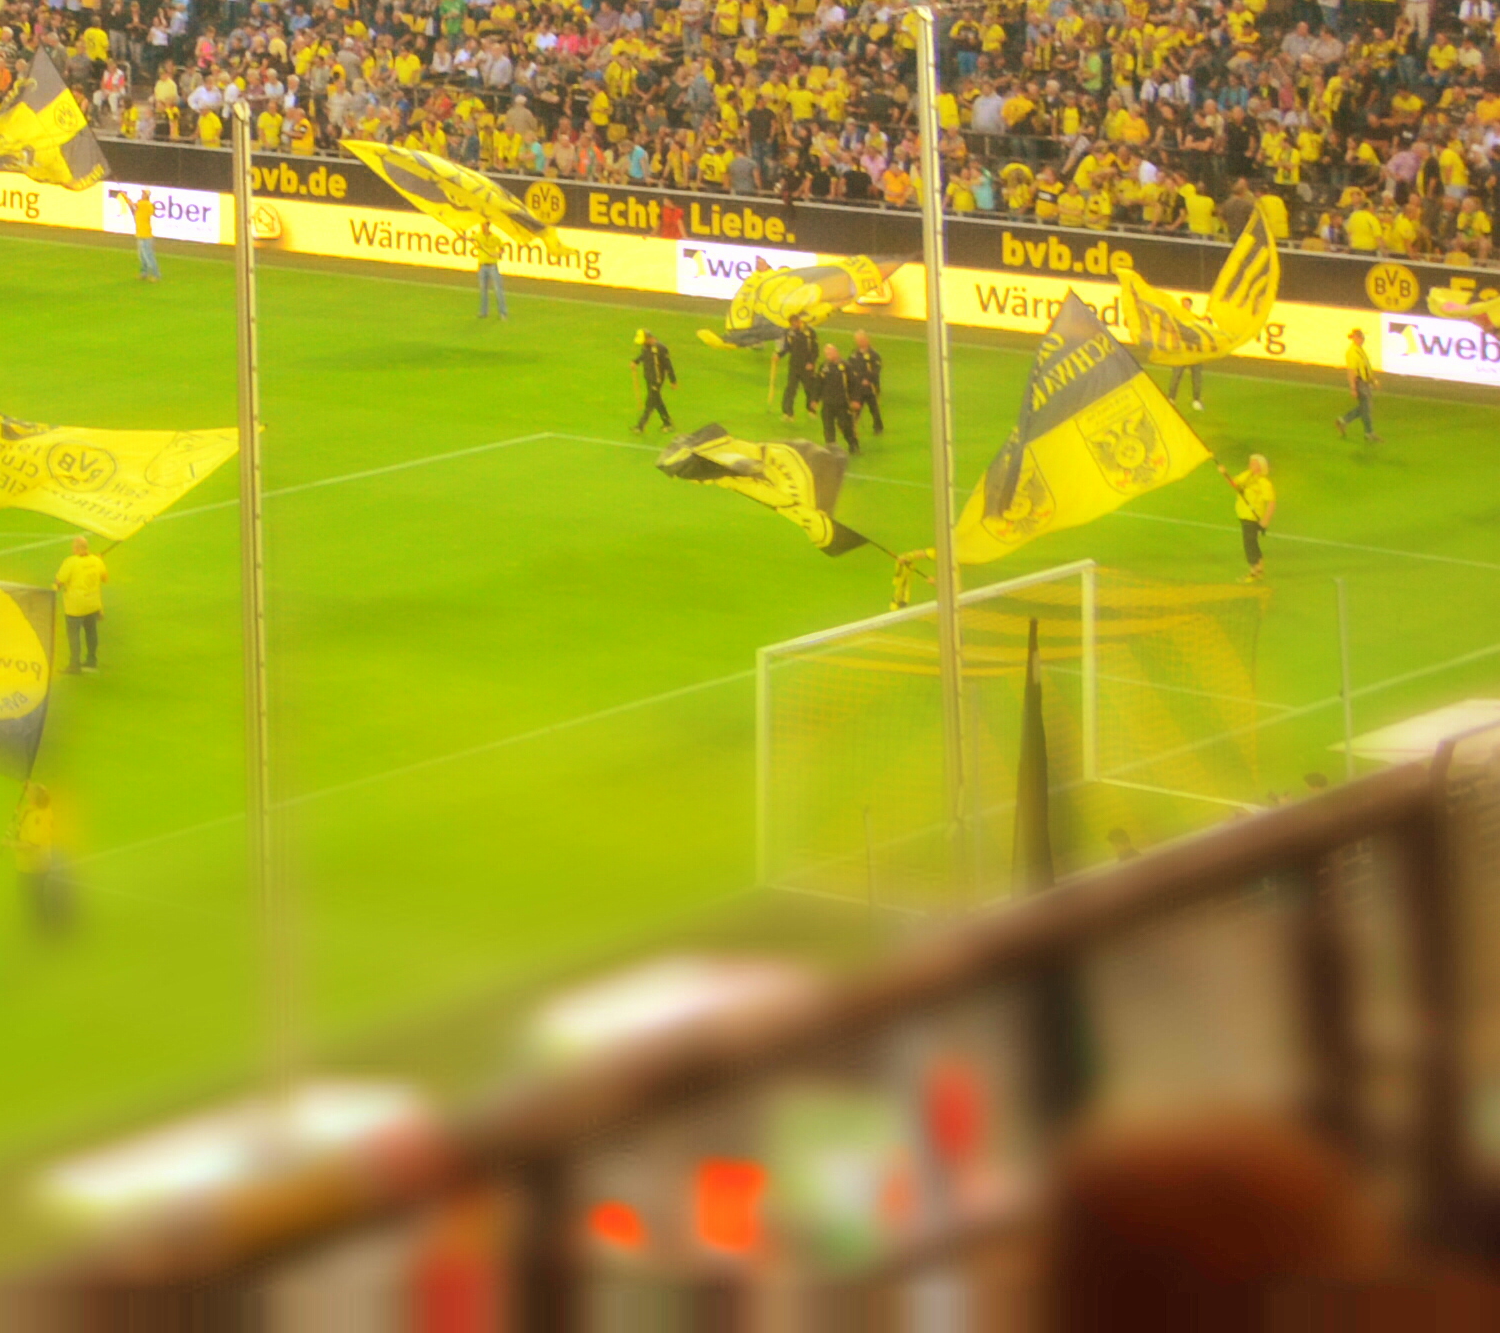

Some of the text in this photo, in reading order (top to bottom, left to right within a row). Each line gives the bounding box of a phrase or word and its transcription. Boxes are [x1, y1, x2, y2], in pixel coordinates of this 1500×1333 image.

[588, 191, 797, 244] Echt Liebe.
[1001, 231, 1135, 277] bvb.de
